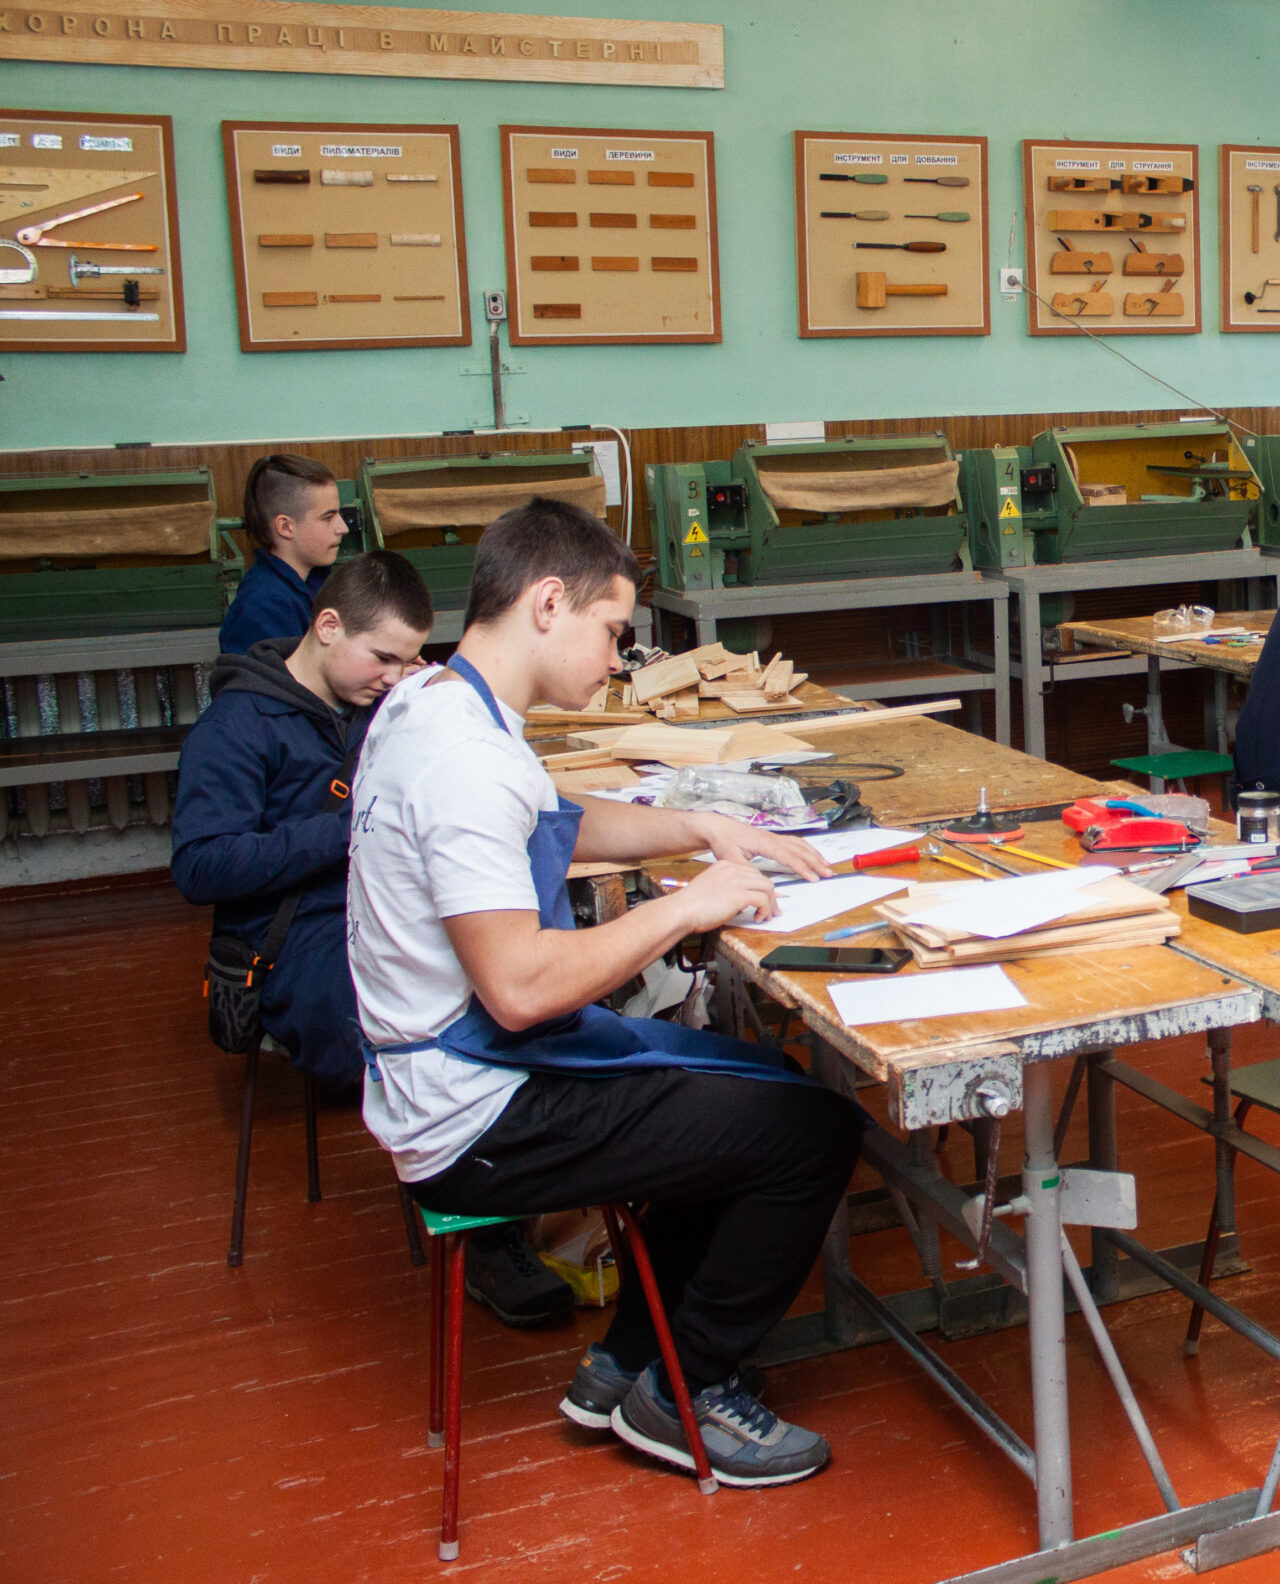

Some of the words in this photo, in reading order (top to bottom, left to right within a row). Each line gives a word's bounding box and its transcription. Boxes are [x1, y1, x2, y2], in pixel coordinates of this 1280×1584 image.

[216, 24, 345, 52] ПРАЦІ
[379, 32, 395, 49] В
[429, 34, 662, 60] МАЙСТЕРНІ
[273, 147, 300, 155] ВИДИ
[322, 147, 400, 156] ПИЛОМАТЕРІАЛІВ
[553, 149, 577, 157] ВИДИ
[608, 151, 652, 159] ДЕРЕВИНИ
[835, 154, 881, 163] ІНСТРУМЕНТ
[891, 155, 907, 163] ДЛЯ
[915, 156, 956, 164] ДОВБАННЯ
[1056, 160, 1098, 169] ІНСТРУМЕНТ
[1110, 161, 1124, 169] ДЛЯ
[1134, 162, 1172, 170] СТРУГАННЯ
[1005, 462, 1014, 481] 4
[352, 796, 378, 833] rt.
